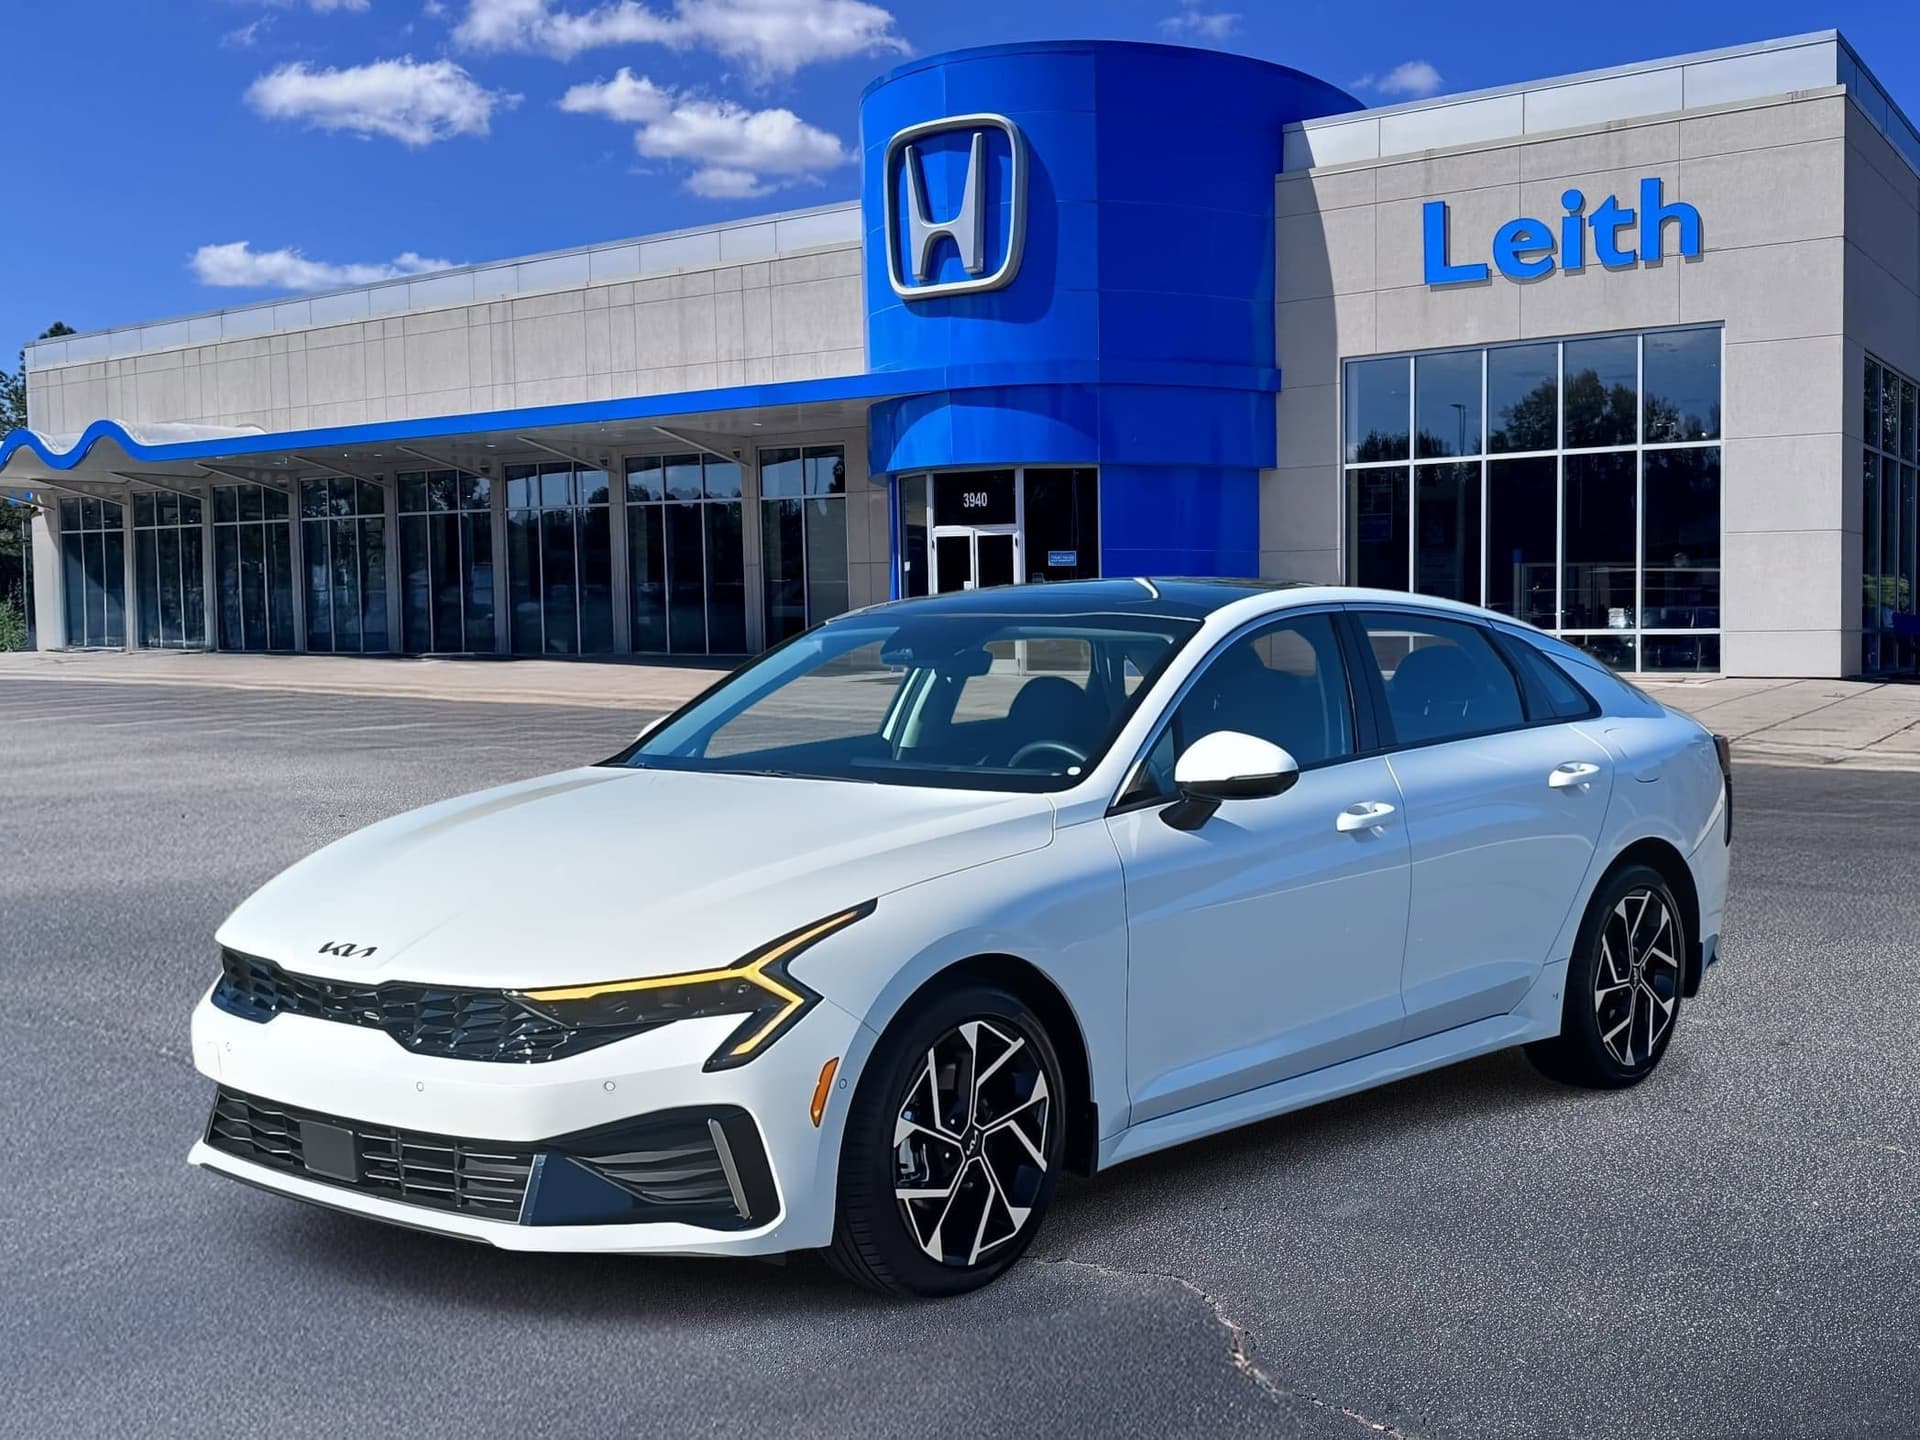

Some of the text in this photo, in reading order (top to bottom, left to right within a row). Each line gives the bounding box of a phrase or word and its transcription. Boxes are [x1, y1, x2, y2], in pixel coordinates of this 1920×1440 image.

[1423, 177, 1700, 285] Leith
[963, 492, 988, 508] 3940
[318, 941, 378, 958] KIA
